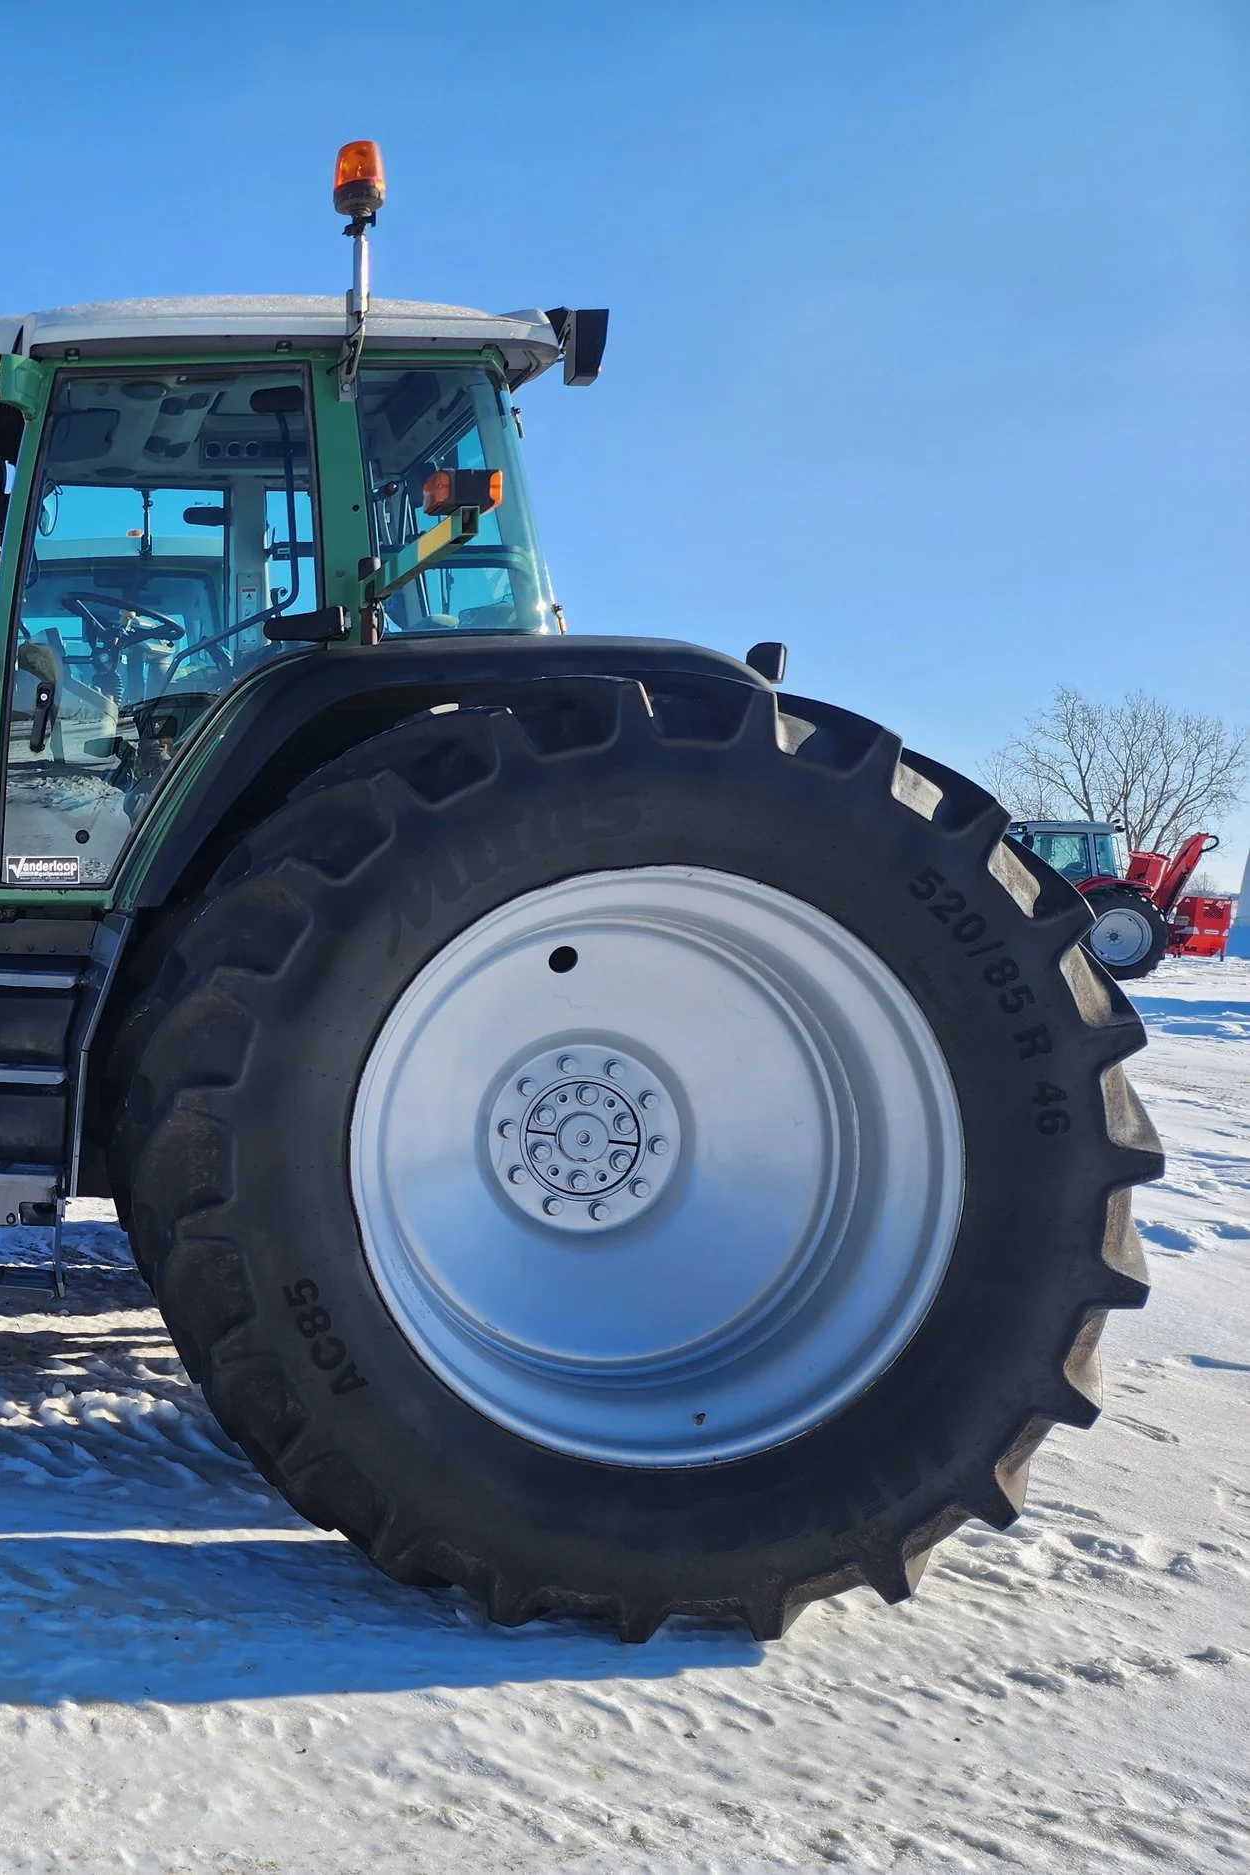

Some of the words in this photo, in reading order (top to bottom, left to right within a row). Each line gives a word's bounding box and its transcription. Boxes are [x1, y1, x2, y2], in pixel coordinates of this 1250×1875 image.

[8, 857, 78, 879] Vanderloop
[907, 865, 1036, 1014] 520/85
[1012, 1022, 1053, 1061] R
[1031, 1079, 1070, 1136] 46
[282, 1278, 370, 1395] AC85
